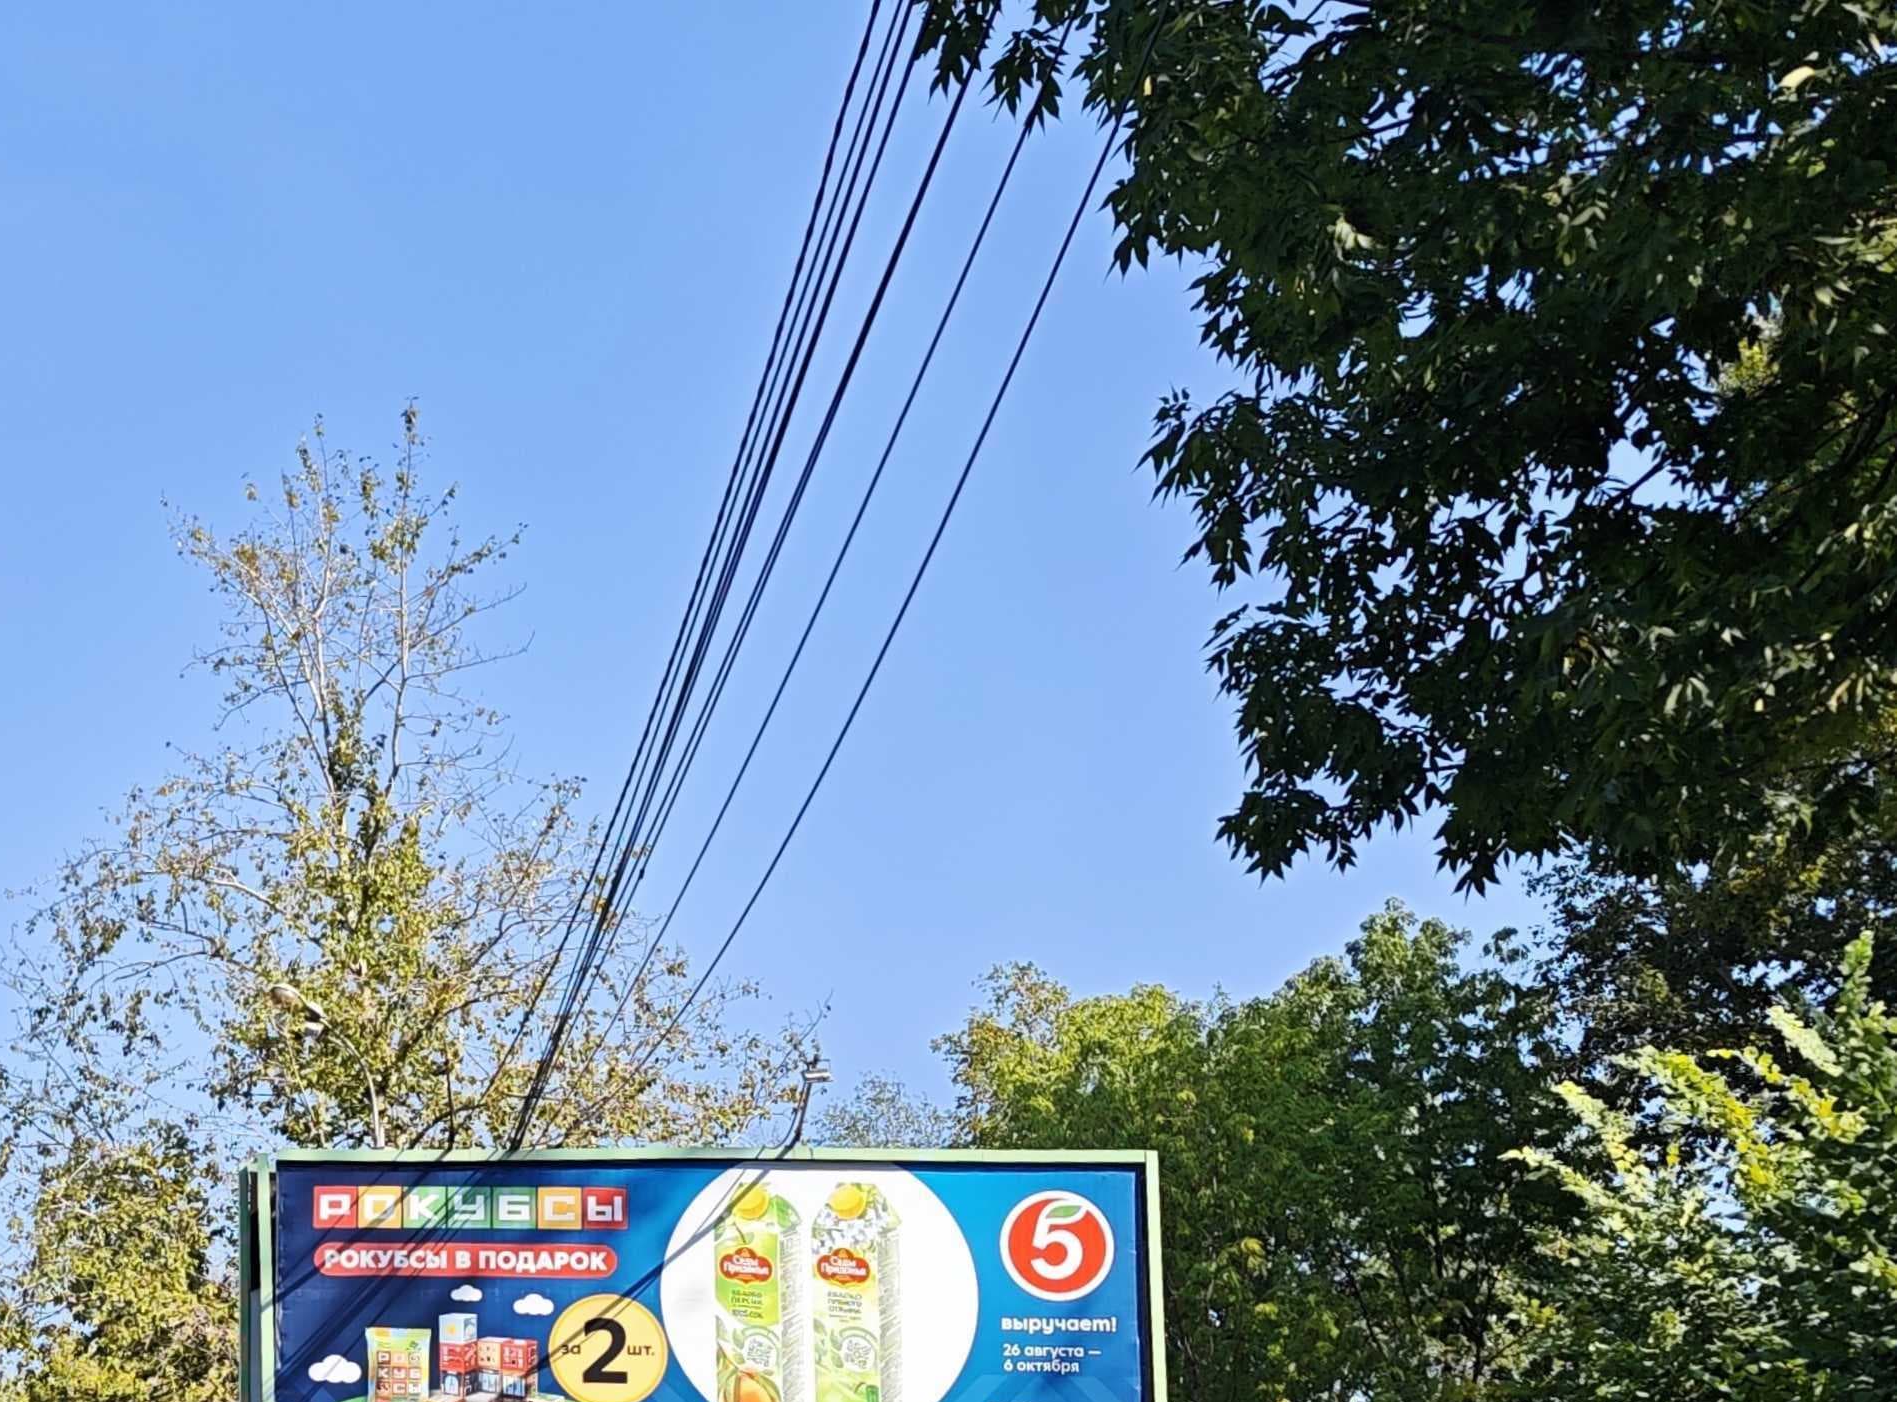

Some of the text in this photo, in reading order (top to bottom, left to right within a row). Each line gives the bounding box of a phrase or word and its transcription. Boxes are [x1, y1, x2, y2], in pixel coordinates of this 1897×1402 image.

[318, 1193, 624, 1223] РОКУБСЫ
[1031, 1199, 1088, 1281] 5
[325, 1249, 607, 1273] РОКУБСЫ В ПОДАРОК
[1001, 1316, 1117, 1335] выручает!
[562, 1317, 655, 1384] за 2 шт.
[1003, 1343, 1084, 1359] 26 августа
[1003, 1359, 1079, 1374] 6 октября
